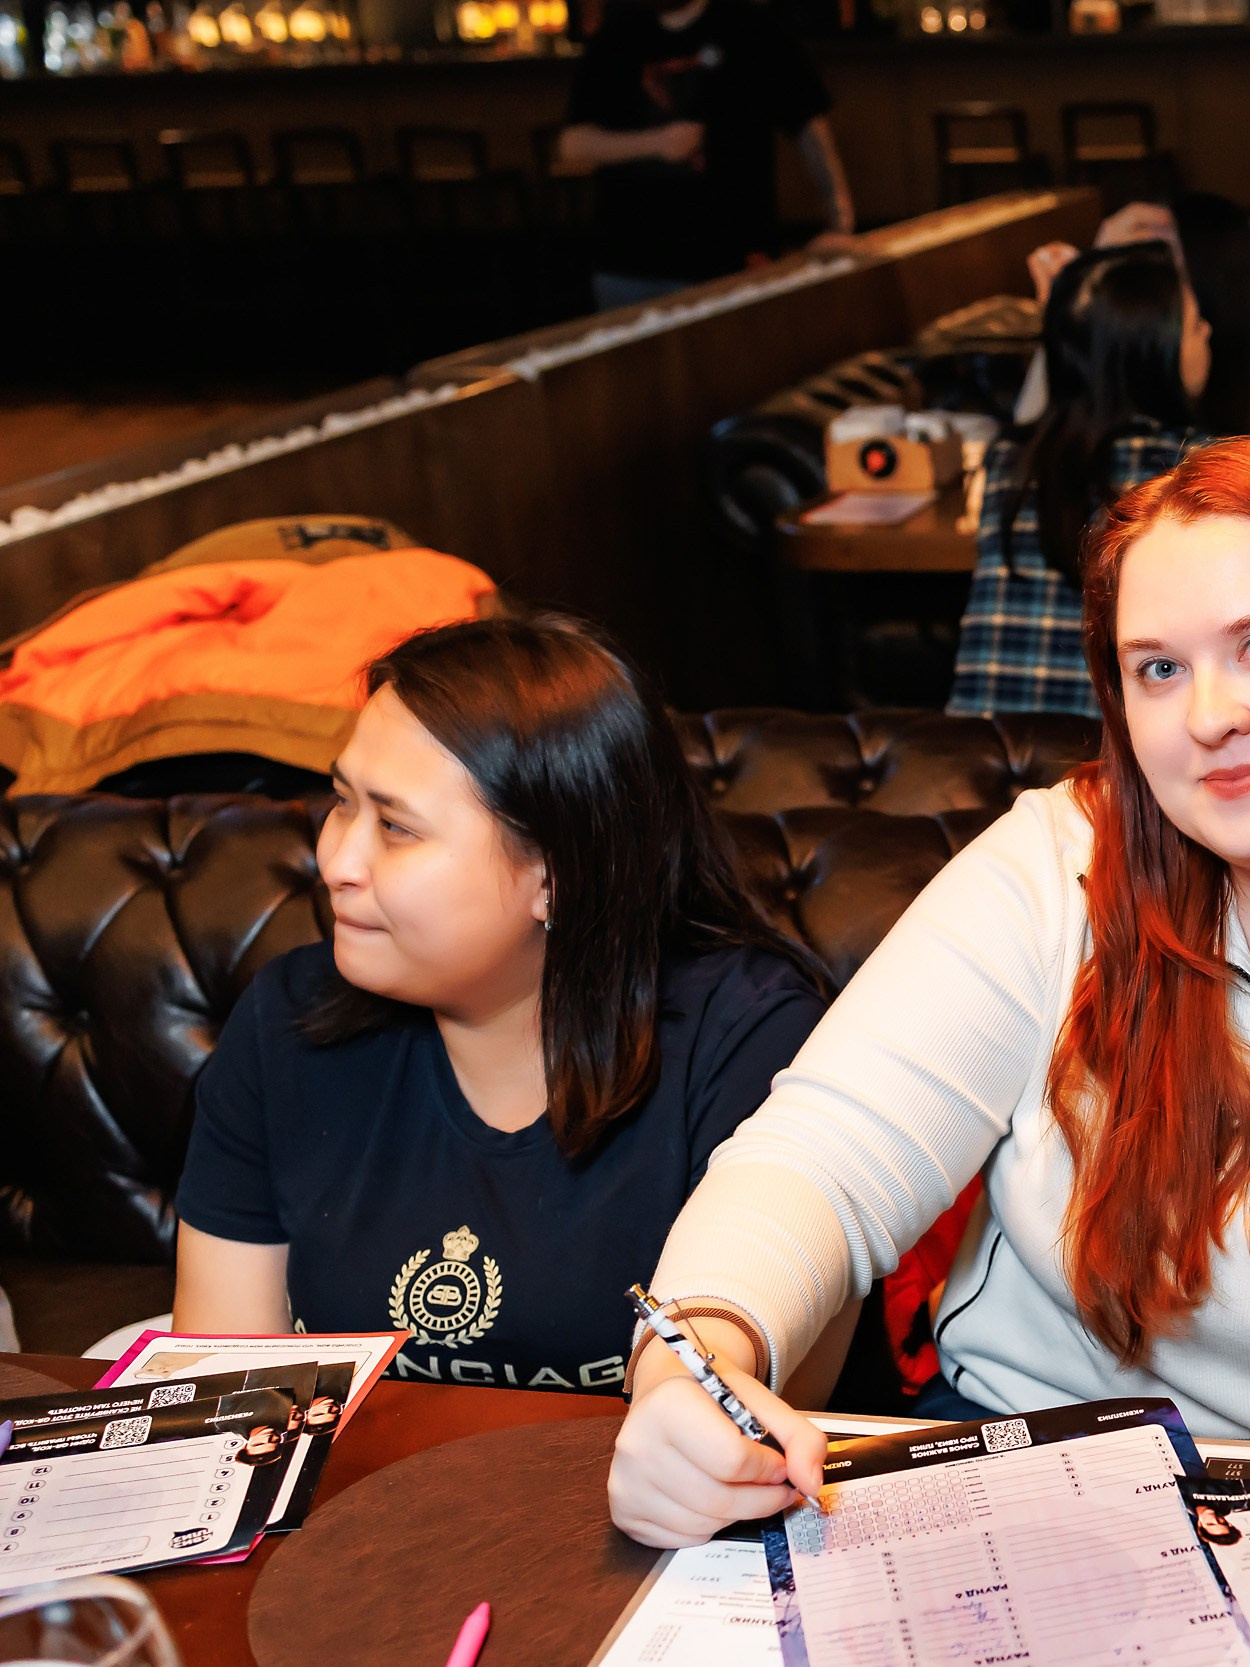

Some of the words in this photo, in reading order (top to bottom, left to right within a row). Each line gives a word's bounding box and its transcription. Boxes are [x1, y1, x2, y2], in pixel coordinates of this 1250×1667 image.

[382, 1352, 625, 1388] NCIAG
[1097, 1409, 1144, 1422] #КВИЗПЛИЗ
[960, 1436, 978, 1444] ПРО
[912, 1447, 948, 1459] ВАЖНОЕ
[949, 1442, 980, 1452] САМОЕ
[822, 1461, 852, 1470] QUIZPL
[1143, 1481, 1176, 1492] АУНД
[965, 1584, 1008, 1597] РАУНД
[985, 1652, 1029, 1664] РАУНД
